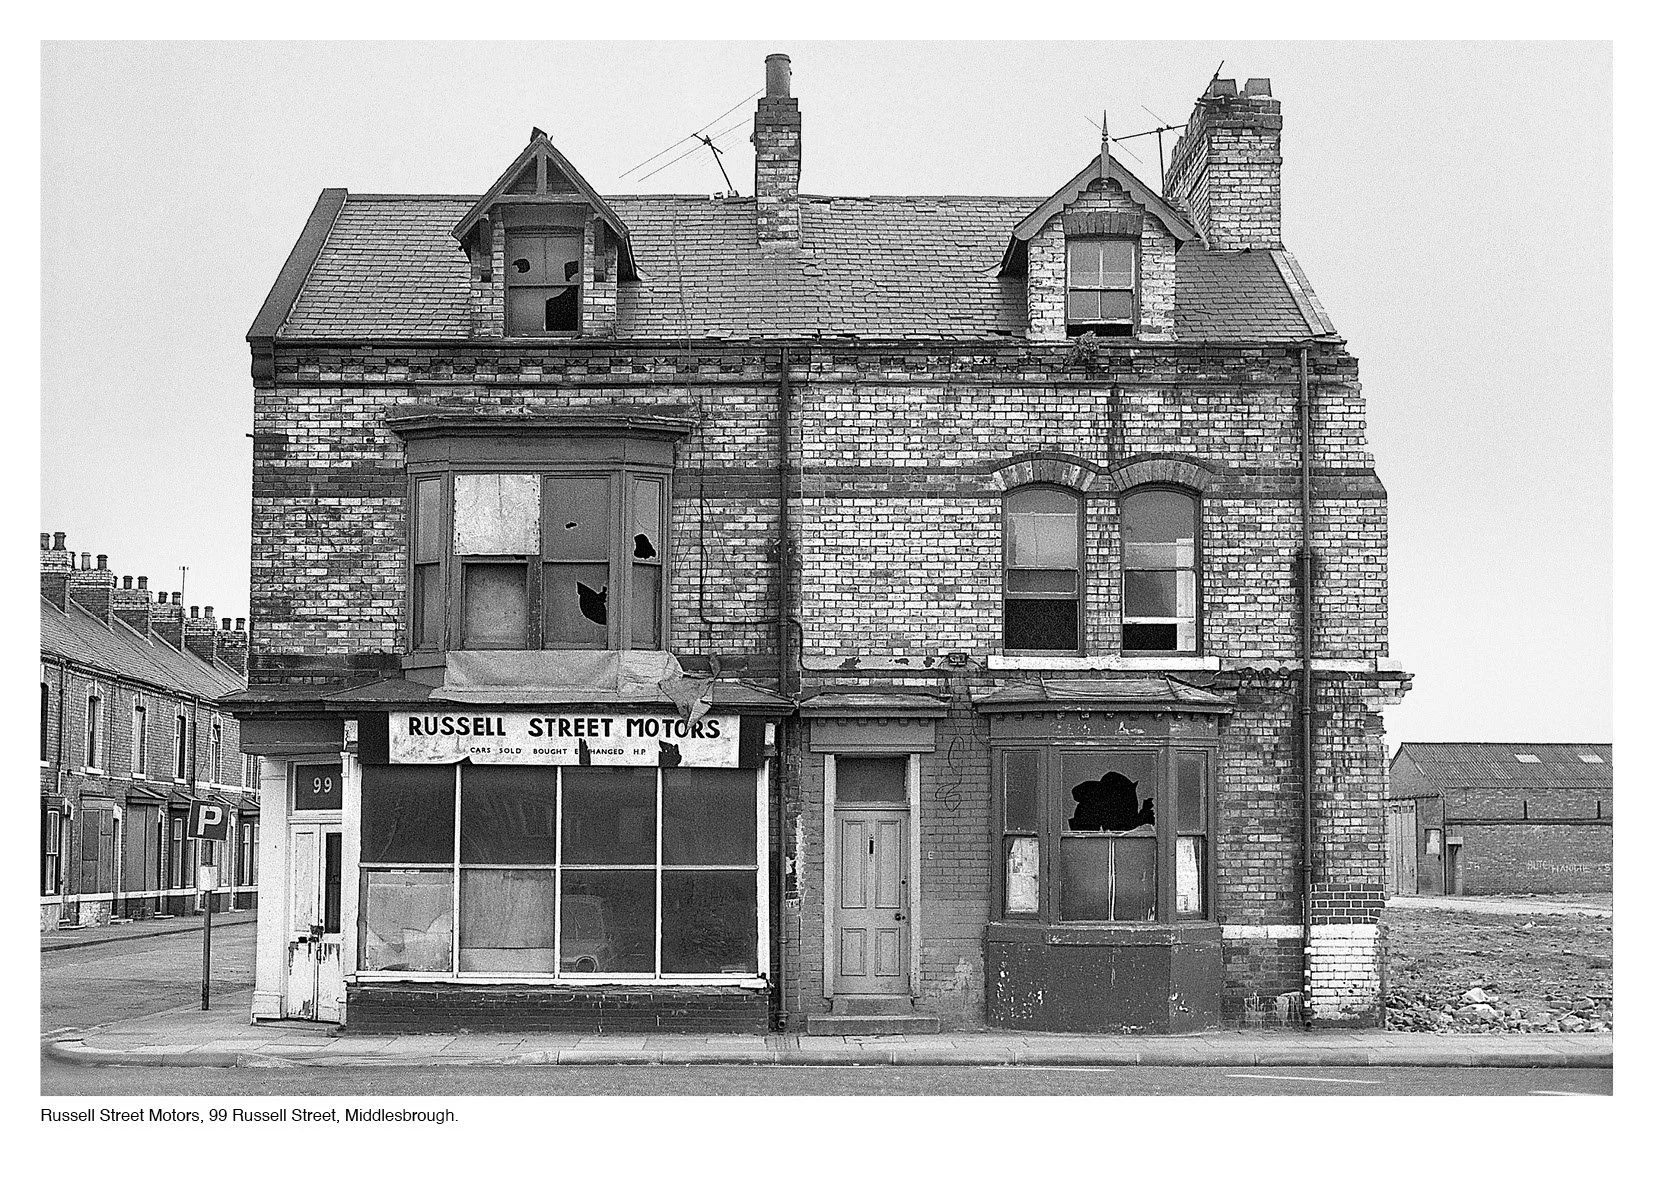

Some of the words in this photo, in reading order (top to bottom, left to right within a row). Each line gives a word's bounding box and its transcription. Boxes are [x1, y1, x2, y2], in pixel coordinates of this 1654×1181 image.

[409, 716, 506, 736] RUSSELL
[528, 717, 614, 737] STREET
[626, 718, 721, 738] MOTORS
[313, 777, 332, 794] 99
[197, 804, 223, 836] P
